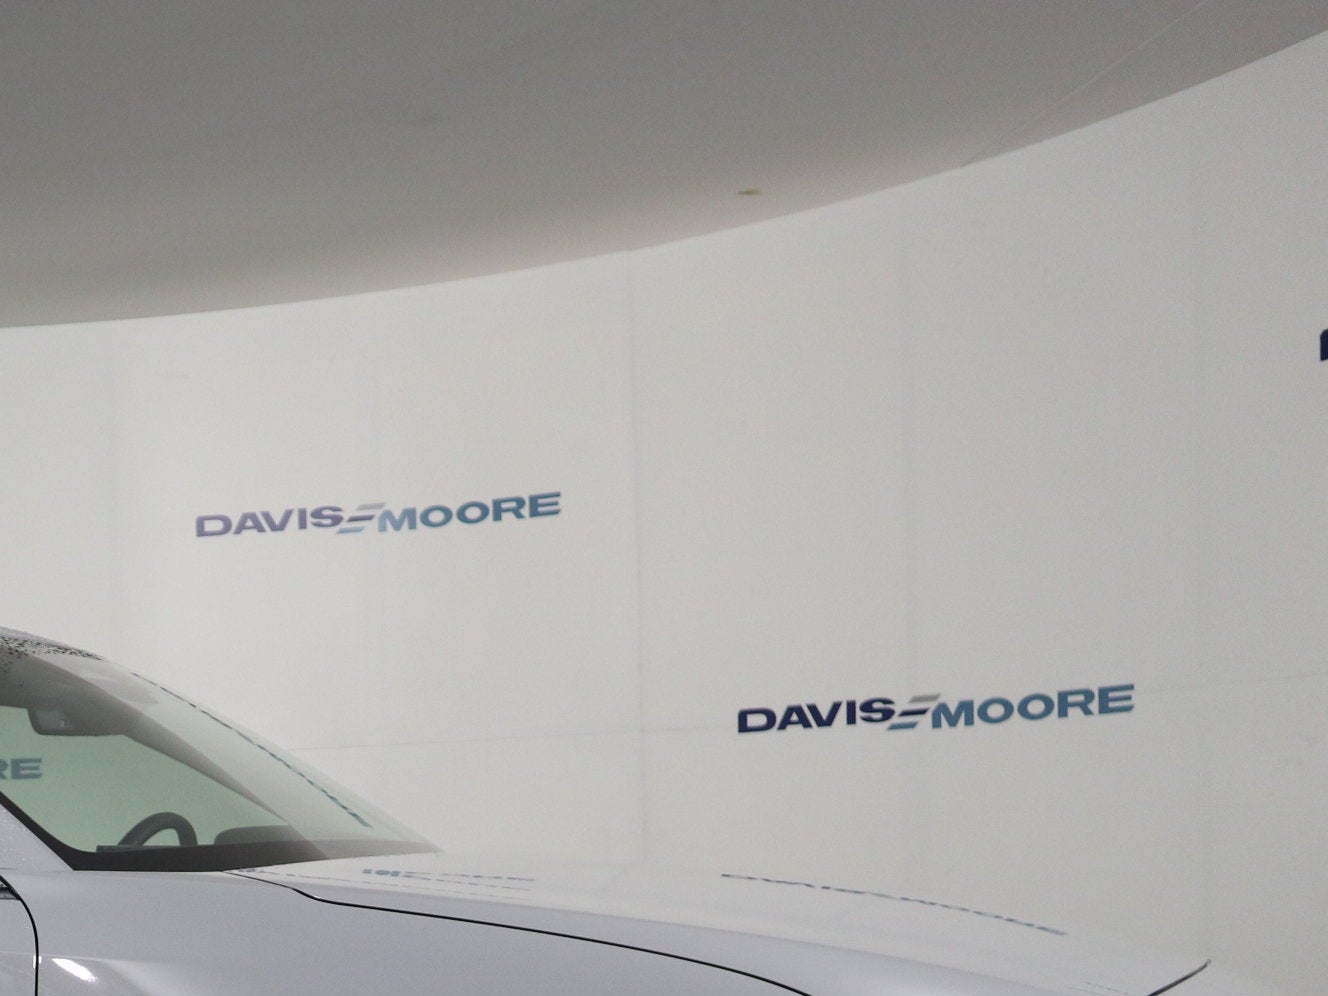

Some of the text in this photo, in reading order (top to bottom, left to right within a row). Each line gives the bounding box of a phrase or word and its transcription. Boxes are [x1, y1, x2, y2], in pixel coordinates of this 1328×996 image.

[195, 491, 562, 538] DAVIS MOORE
[738, 683, 1135, 733] DAVIS MOORE
